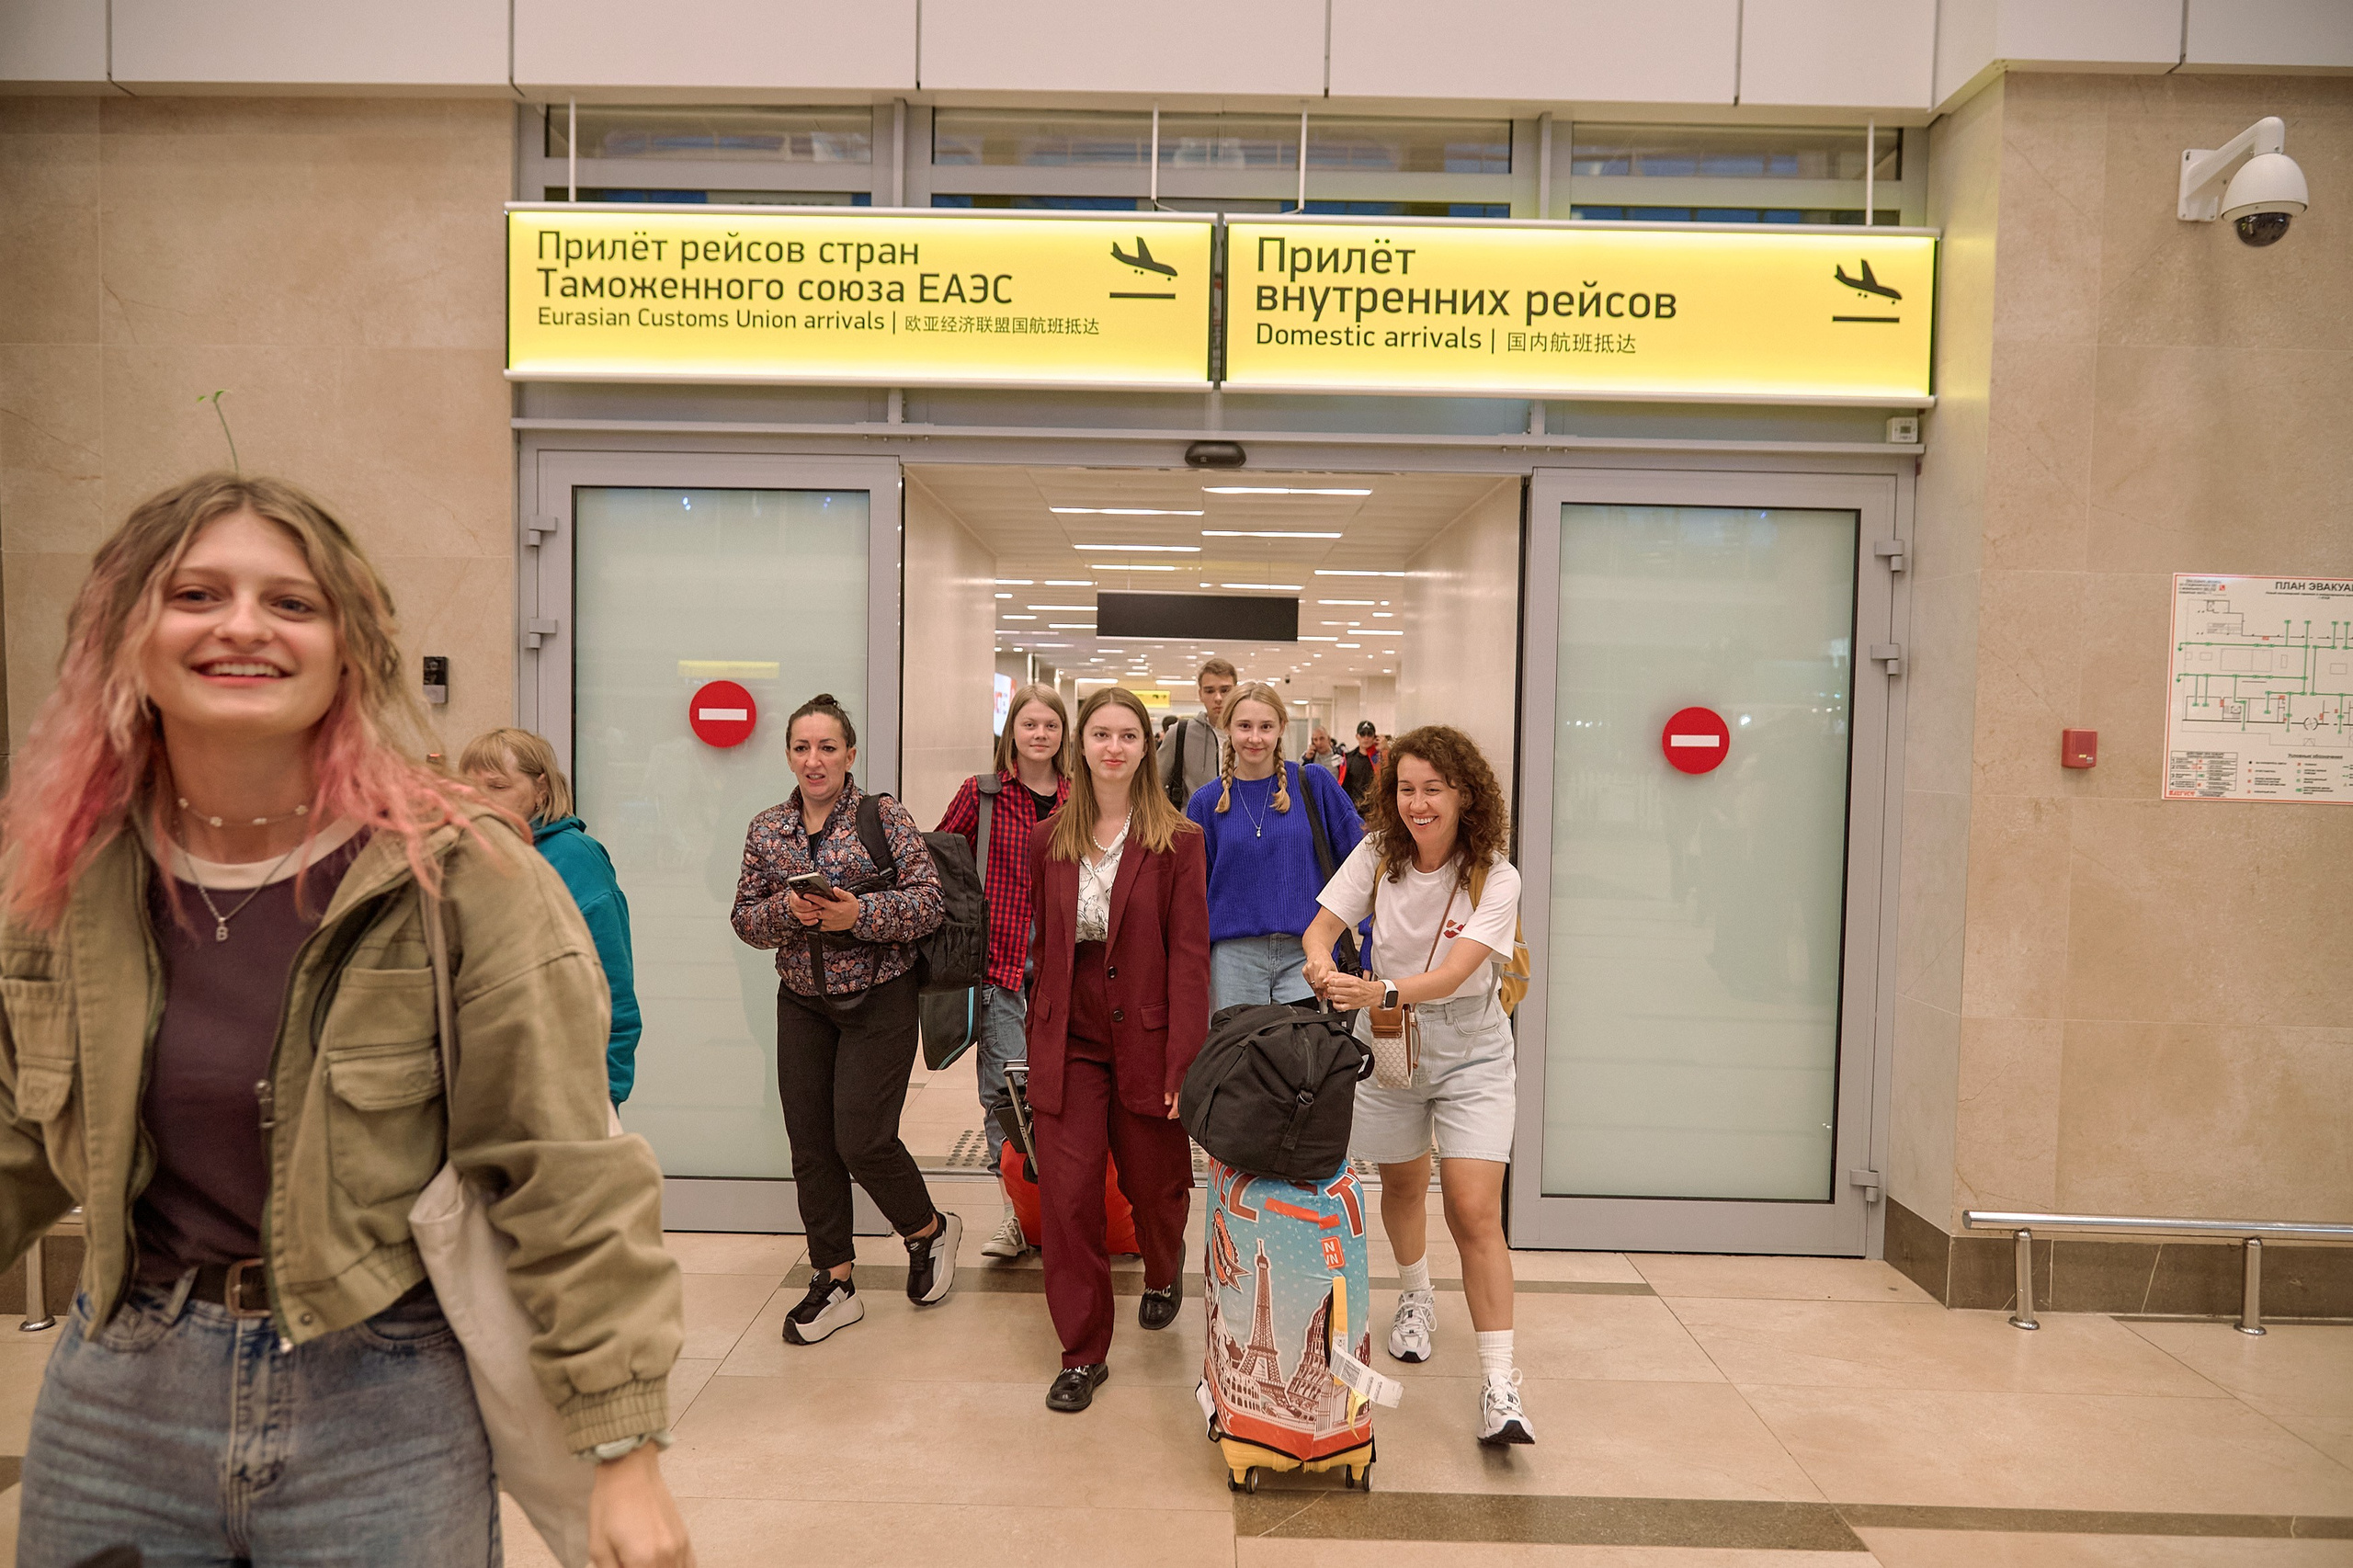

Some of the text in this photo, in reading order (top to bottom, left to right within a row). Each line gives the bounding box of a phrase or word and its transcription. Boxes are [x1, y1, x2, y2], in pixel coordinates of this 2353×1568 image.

[538, 230, 918, 272] Прилёт рейсов стран
[1257, 236, 1416, 283] Прилёт
[536, 267, 1013, 304] Таможенного союза ЕАЭС
[1256, 280, 1677, 326] внутренних рейсов
[539, 306, 885, 330] Eurasian Customs Union arrivals
[904, 315, 1100, 335] 欧亚经济联盟国航班抵达
[1256, 323, 1482, 349] Domestic arrivals
[1507, 332, 1636, 354] 国内航班抵达
[2275, 581, 2353, 592] ПЛАН ЭВАКУА
